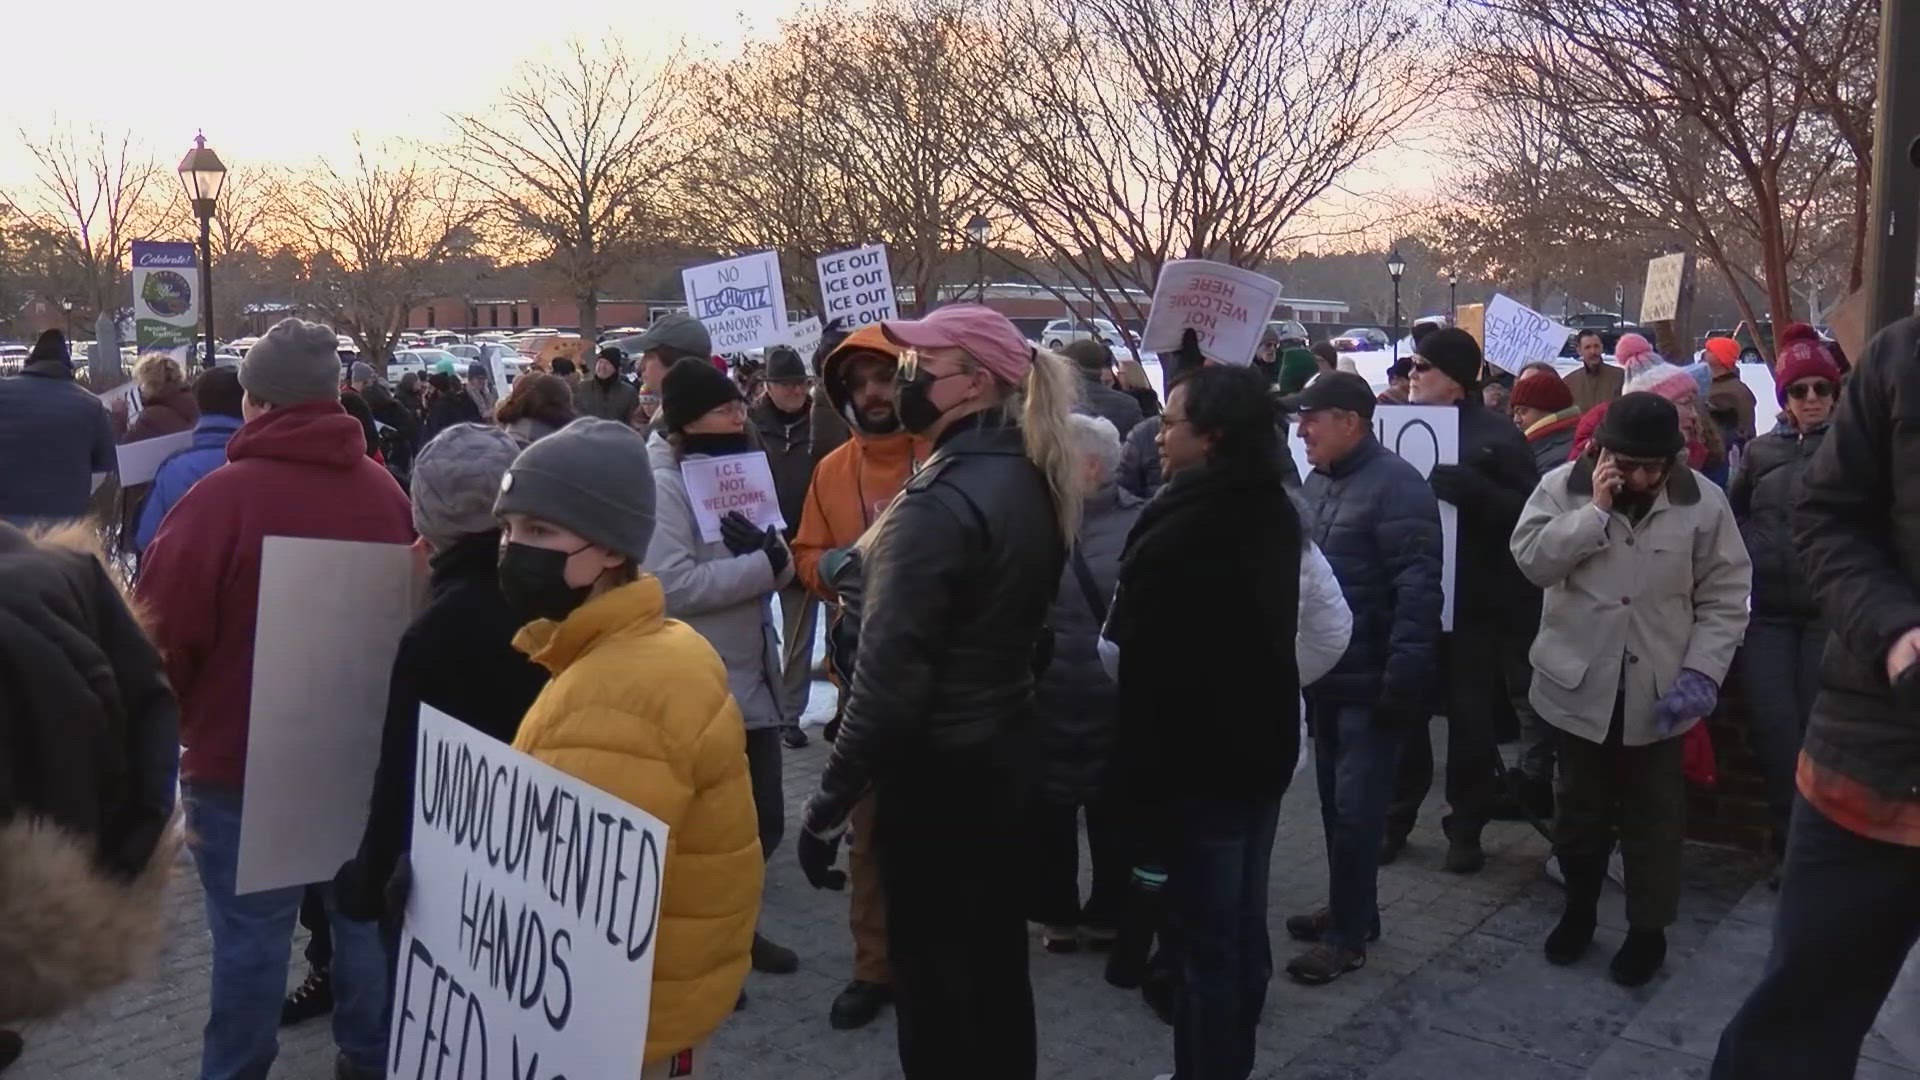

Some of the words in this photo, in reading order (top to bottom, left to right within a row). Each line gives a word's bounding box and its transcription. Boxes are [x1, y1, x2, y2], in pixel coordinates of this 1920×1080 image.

[139, 253, 191, 266] Celebrate!
[822, 258, 845, 276] ICE
[849, 251, 881, 270] OUT
[717, 265, 740, 284] NO
[827, 277, 848, 294] ICE
[852, 269, 884, 289] OUT
[1189, 277, 1236, 297] HERE
[829, 295, 852, 312] ICE
[856, 288, 887, 307] OUT
[1168, 294, 1248, 324] WELCOME
[860, 306, 891, 325] OUT
[1183, 311, 1217, 330] NOT
[1512, 306, 1550, 334] STOP
[708, 316, 762, 337] HANOVER
[1485, 312, 1558, 361] SEPARATING
[718, 332, 759, 347] COUNTY
[719, 478, 745, 492] NOT
[702, 491, 768, 511] WELCOME
[420, 729, 660, 962] UNDOCUMENTED
[458, 866, 572, 1032] HANDS
